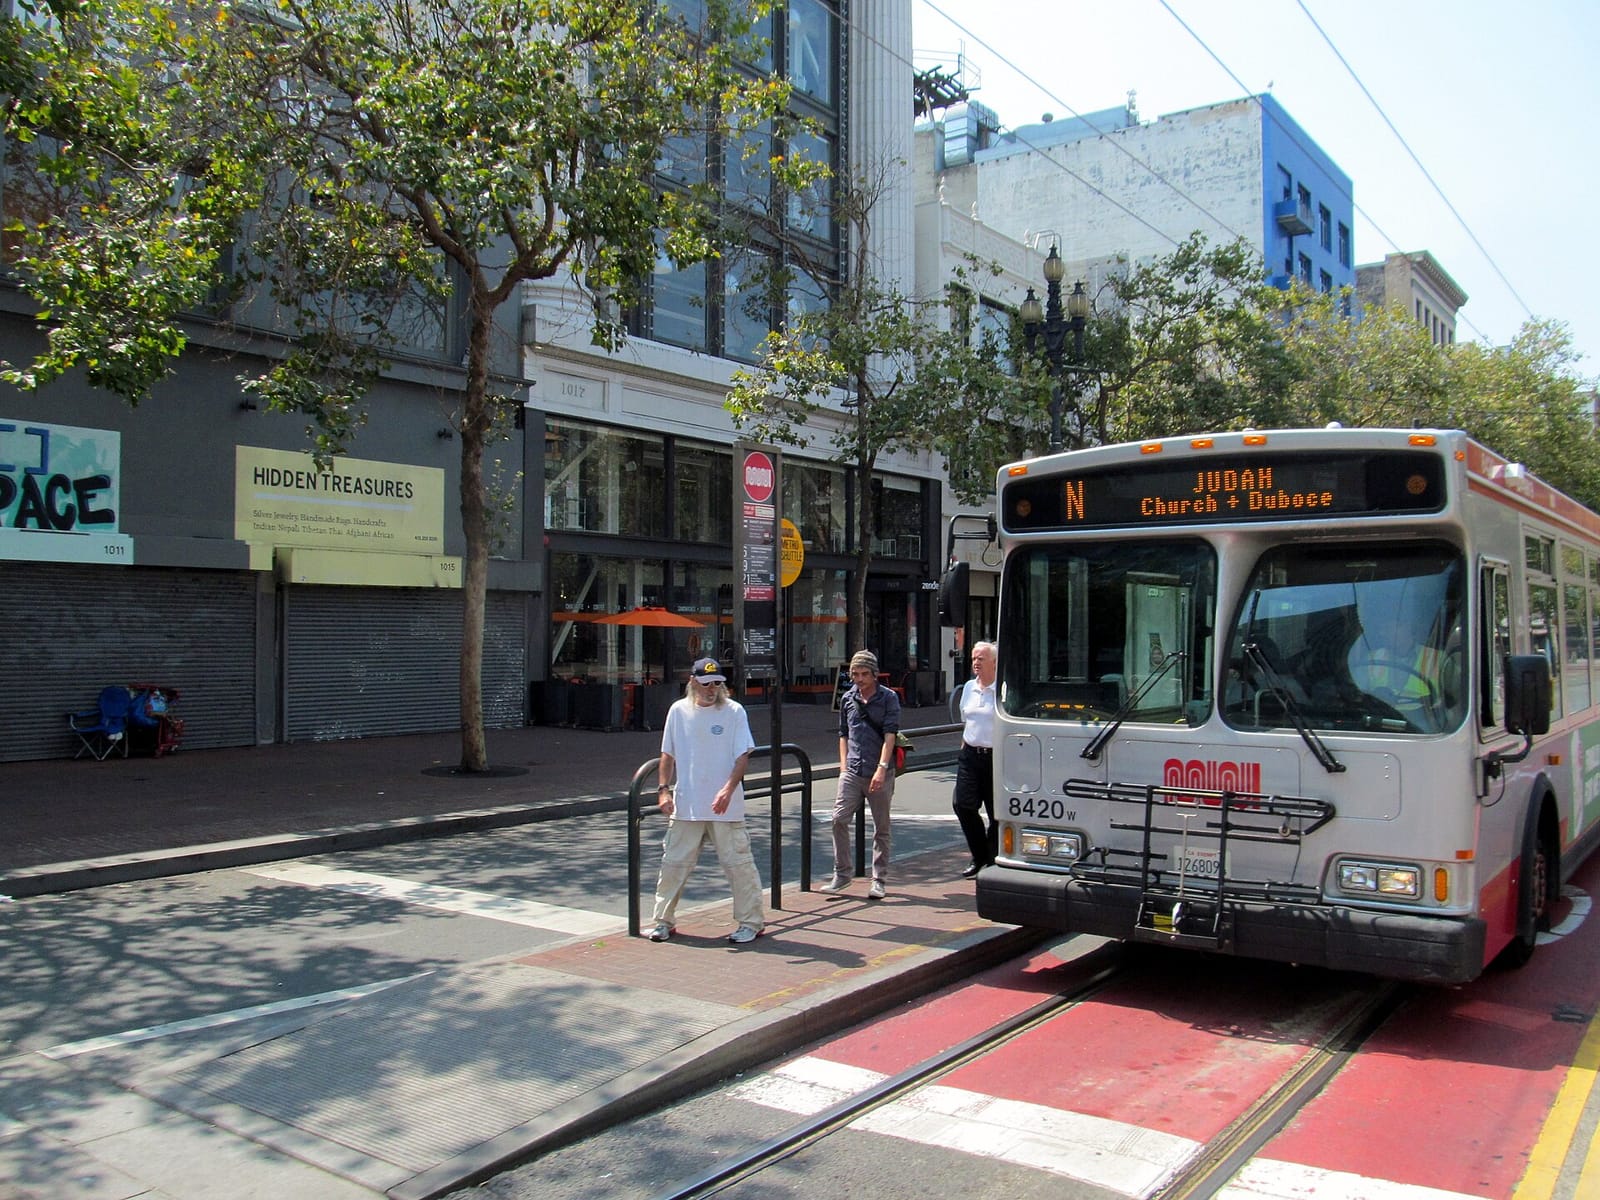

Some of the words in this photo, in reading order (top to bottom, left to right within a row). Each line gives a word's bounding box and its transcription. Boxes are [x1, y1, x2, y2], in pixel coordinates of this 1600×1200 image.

[561, 382, 585, 398] 1017
[254, 466, 316, 490] HIDDEN
[321, 473, 413, 499] TREASURES
[1193, 467, 1272, 493] JUDAH
[1066, 480, 1084, 520] N
[1141, 494, 1217, 516] Church
[1249, 490, 1333, 510] Duboce
[104, 545, 125, 555] 1011
[440, 562, 456, 572] 1015
[1008, 797, 1065, 820] 8420
[1178, 857, 1220, 875] 126809
